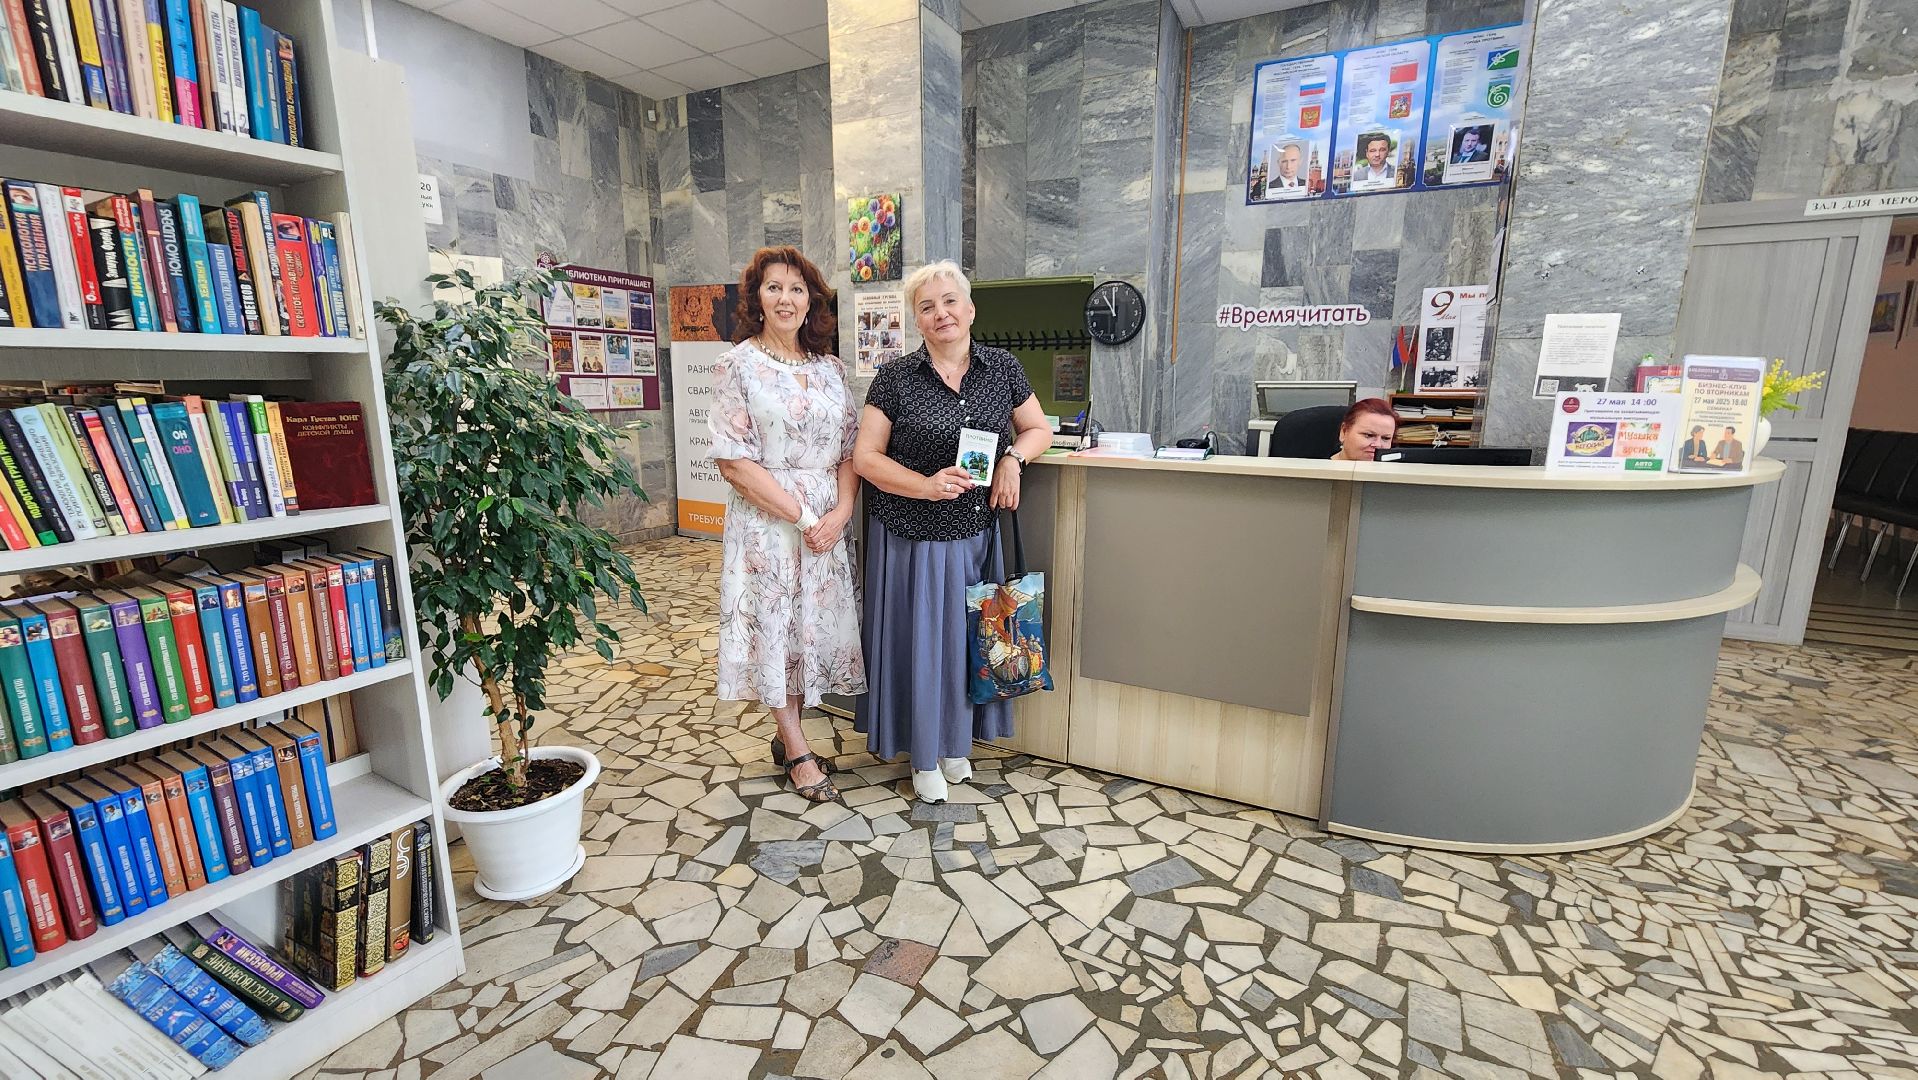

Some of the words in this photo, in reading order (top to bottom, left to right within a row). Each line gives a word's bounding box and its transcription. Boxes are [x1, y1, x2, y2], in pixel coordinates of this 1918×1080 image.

[210, 11, 220, 31] ТЕСТЫ
[226, 16, 235, 35] ТЕСТЫ
[286, 103, 298, 148] ПСИХОЛОГИЯ
[420, 182, 432, 192] 20
[259, 196, 271, 230] ВЛИЯНИЯ
[1812, 202, 1836, 210] ЗАЛ
[1842, 199, 1871, 210] ДЛЯ
[100, 227, 114, 251] Фрейд
[160, 207, 176, 244] LUDENS
[14, 210, 37, 273] ПСИХОЛОГИЯ
[30, 212, 50, 272] УПРАВЛЕНИЯ
[227, 210, 247, 272] ИМАГИНАТОР
[265, 231, 279, 276] ПСИХОЛОГИЯ
[123, 237, 143, 298] ЛИЧНОСТИ
[166, 242, 182, 277] HOMO
[284, 249, 299, 295] УПРАВЛЕНИЕ
[608, 275, 651, 289] ПРИГЛАШАЕТ
[240, 282, 258, 321] ЦВЕТКОВ
[292, 295, 305, 328] СКРЫТОЕ
[1431, 290, 1454, 316] 9
[1219, 307, 1368, 328] #Времячитать
[554, 341, 571, 350] SOUL
[1698, 382, 1747, 390] БИЗНЕС-КЛУБ
[172, 430, 188, 440] ОН
[1, 454, 20, 478] ГРУПП
[14, 479, 42, 519] ПОДРОСТКИ
[688, 513, 724, 526] ТРЕБУЮ
[241, 670, 250, 681] СТО
[233, 844, 242, 854] СТО
[204, 951, 280, 1005] ЕСТЕСТВОЗНАНИЕ
[234, 946, 286, 981] ПРОФЕССИИ
